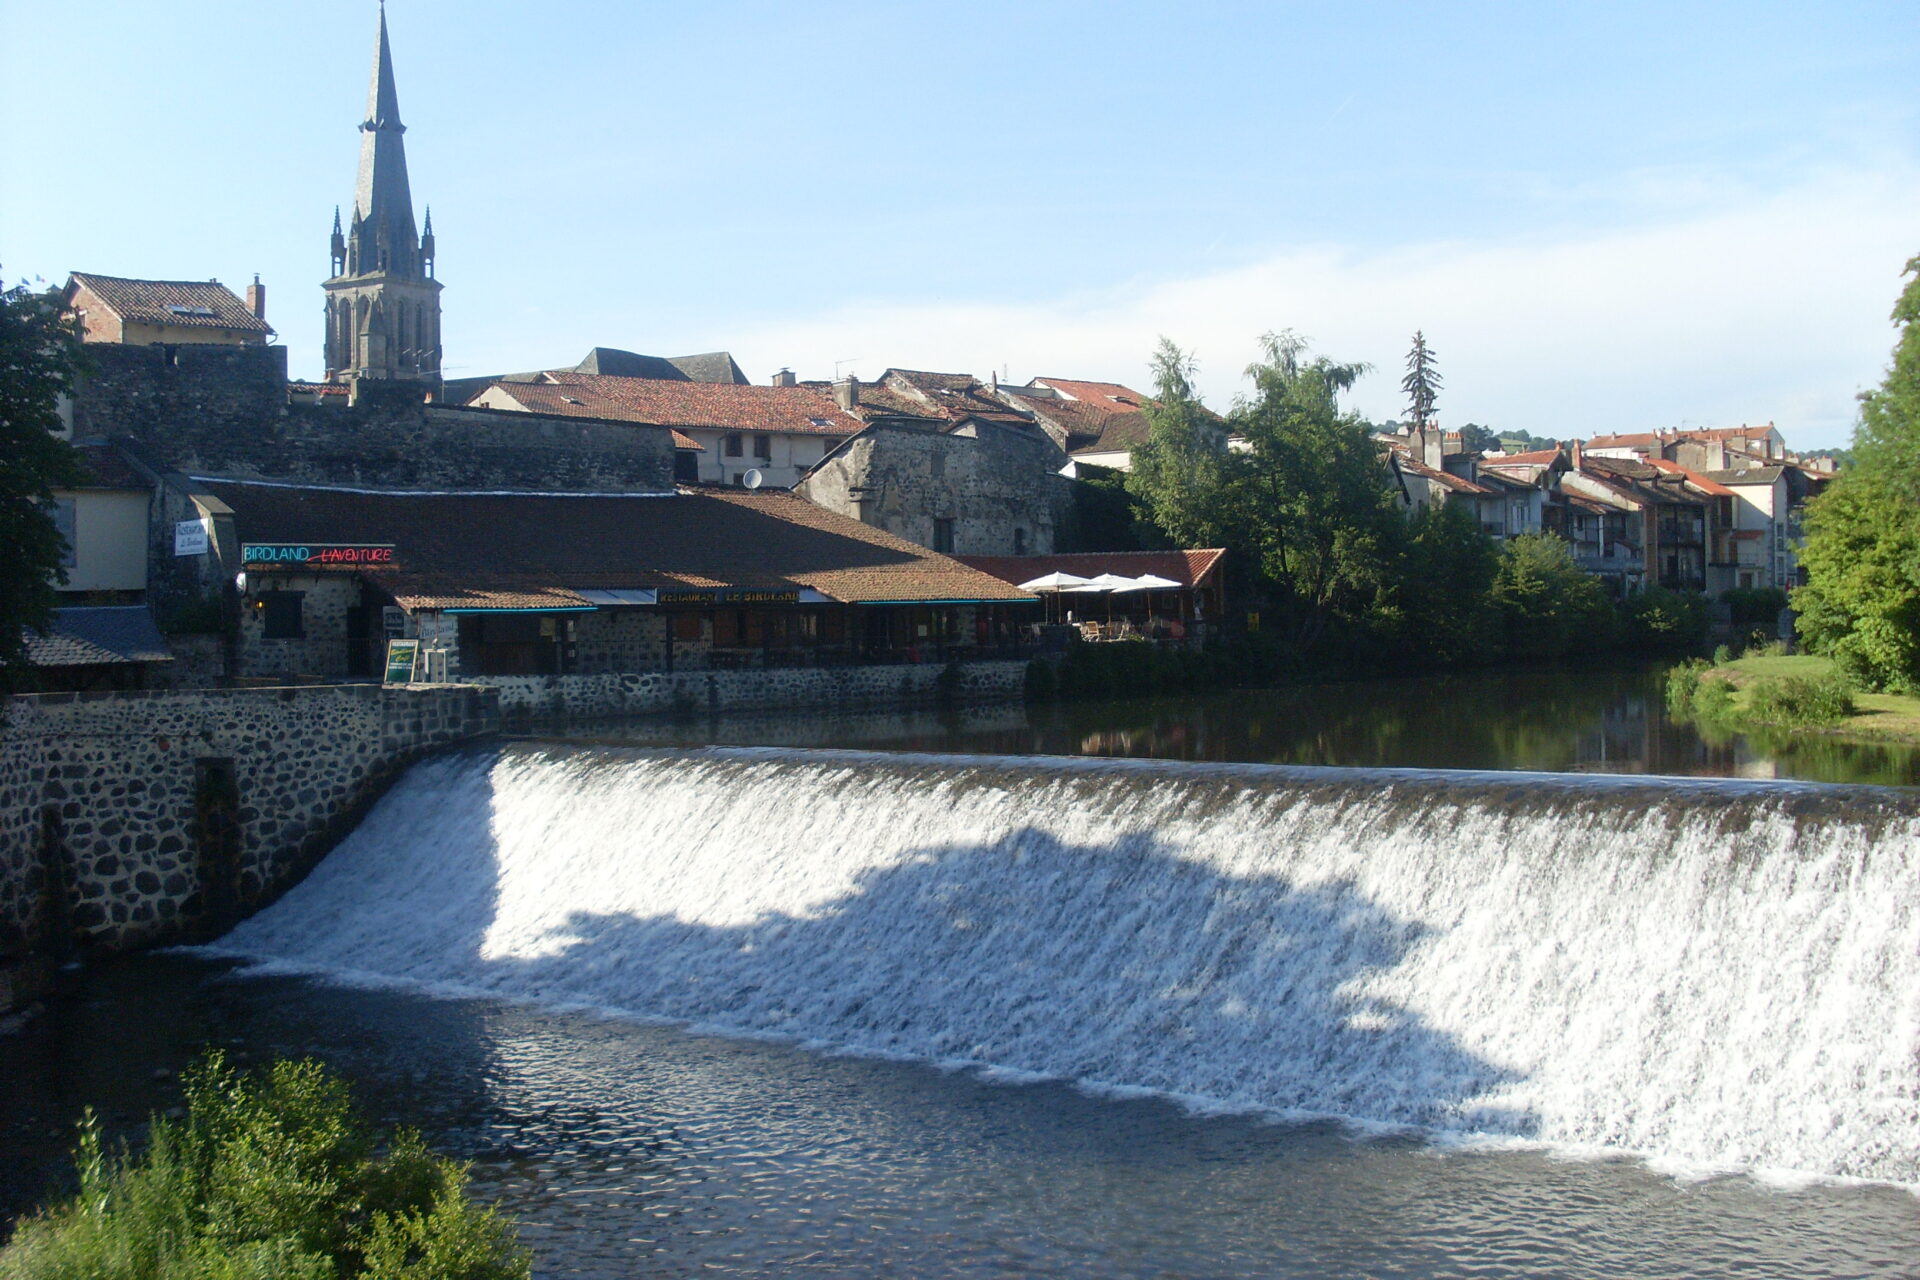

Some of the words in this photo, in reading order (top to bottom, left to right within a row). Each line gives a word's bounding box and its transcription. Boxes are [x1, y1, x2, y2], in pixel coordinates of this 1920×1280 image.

[243, 546, 309, 562] BIRDLAND
[320, 548, 392, 563] L'AVENTURE
[726, 591, 741, 602] LE
[743, 590, 799, 602] BIRDLAND
